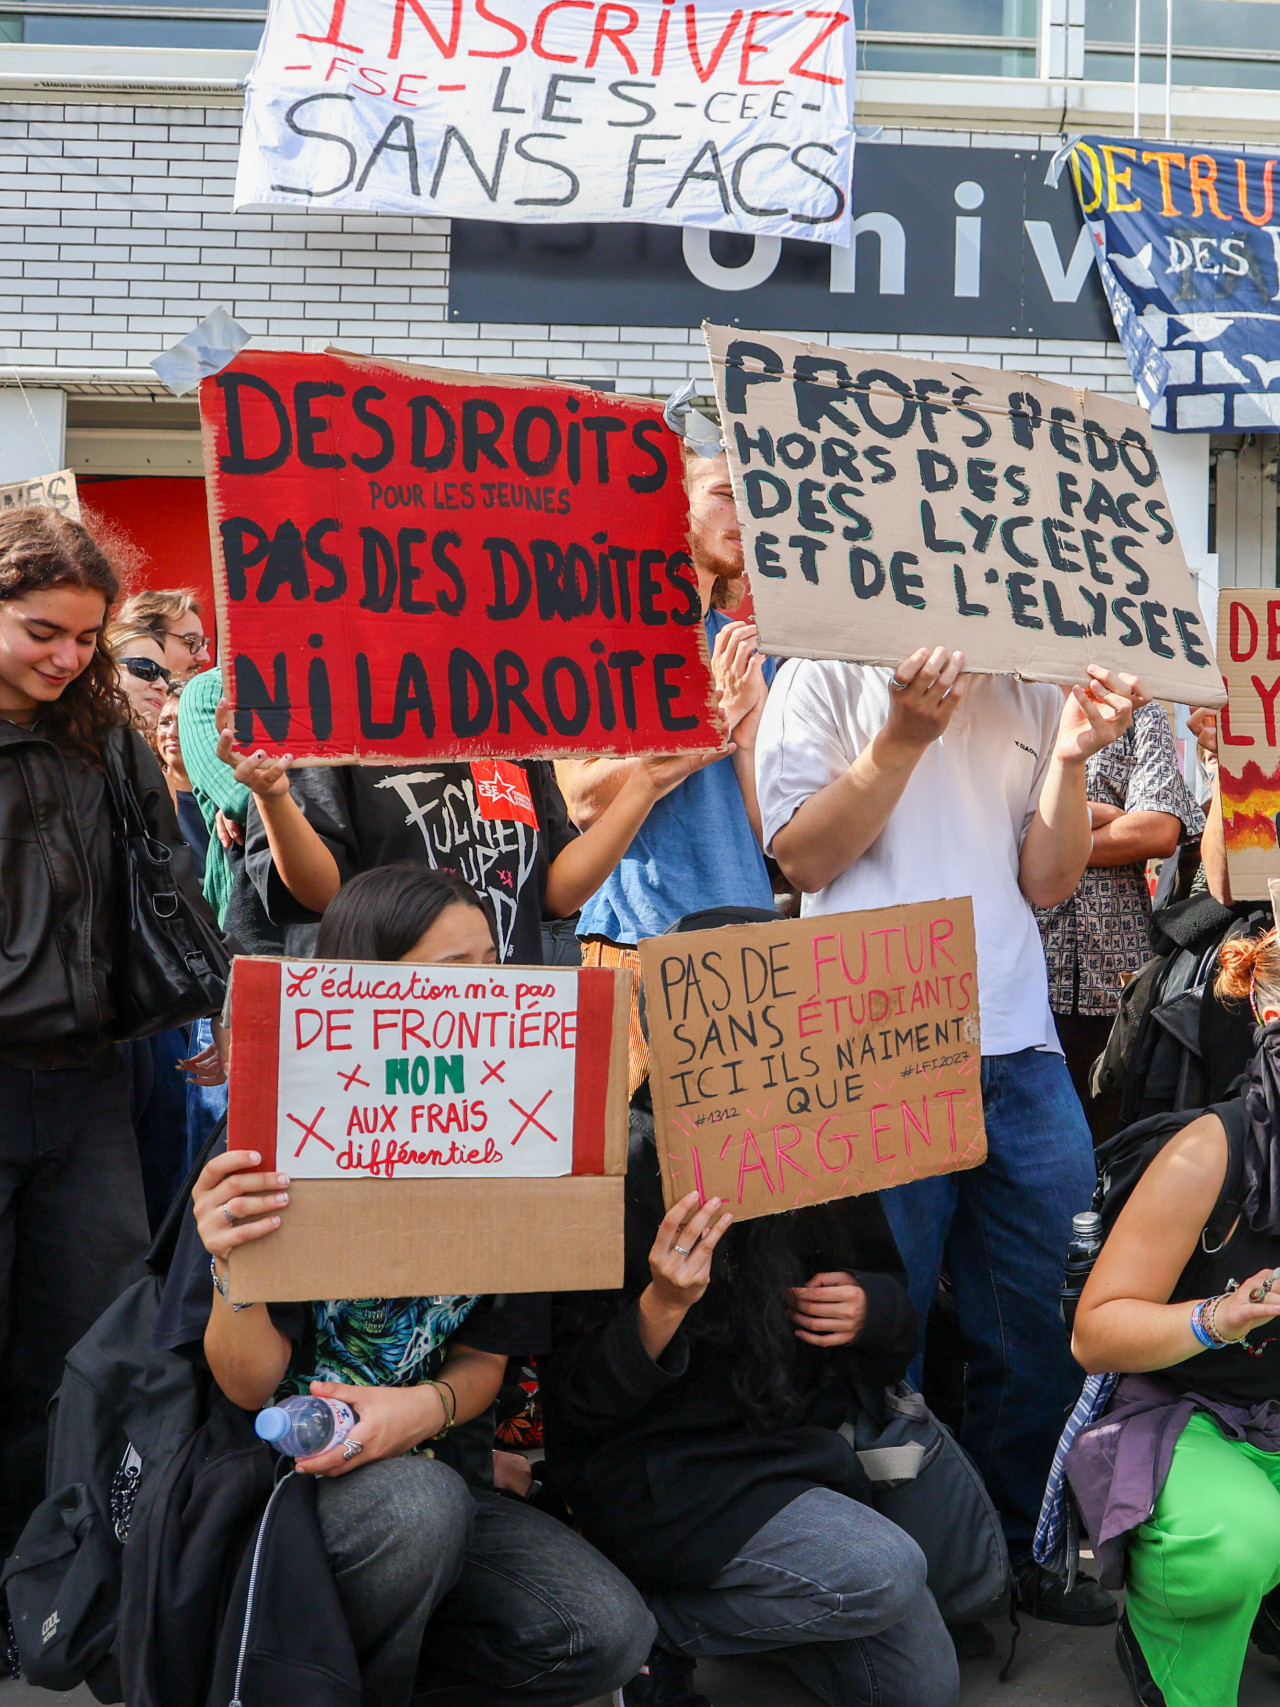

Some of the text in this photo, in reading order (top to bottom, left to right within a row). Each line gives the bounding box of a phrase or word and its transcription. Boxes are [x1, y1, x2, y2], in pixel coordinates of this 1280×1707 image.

[492, 65, 657, 127] LES
[270, 93, 846, 225] SANS FACS
[1164, 235, 1250, 277] DES
[213, 371, 396, 476] DES
[1007, 391, 1159, 488] PEDO
[368, 481, 572, 516] POUR LES JEUNES
[733, 422, 1175, 545] HORS DES FACS
[220, 515, 347, 602] PAS
[357, 525, 466, 617] DES
[742, 468, 1150, 597] DES LYCEES
[754, 531, 1212, 669] ET DE L'ELYSEE
[354, 651, 436, 740] LA
[459, 845, 500, 890] UP
[286, 965, 461, 1001] L'éducation
[515, 982, 556, 1012] pas
[660, 918, 958, 1021] PAS DE FUTUR
[294, 1008, 354, 1052] DE
[669, 1016, 965, 1108] ICI ILS N'AIMENT
[672, 971, 973, 1065] SANS ÉTUDIANTS
[384, 1054, 466, 1096] NON
[785, 1073, 865, 1115] QUE
[900, 1051, 971, 1079] #LFI2027
[335, 1137, 504, 1179] différentiels
[346, 1105, 399, 1137] AUX
[691, 1088, 967, 1207] L'ARGENT
